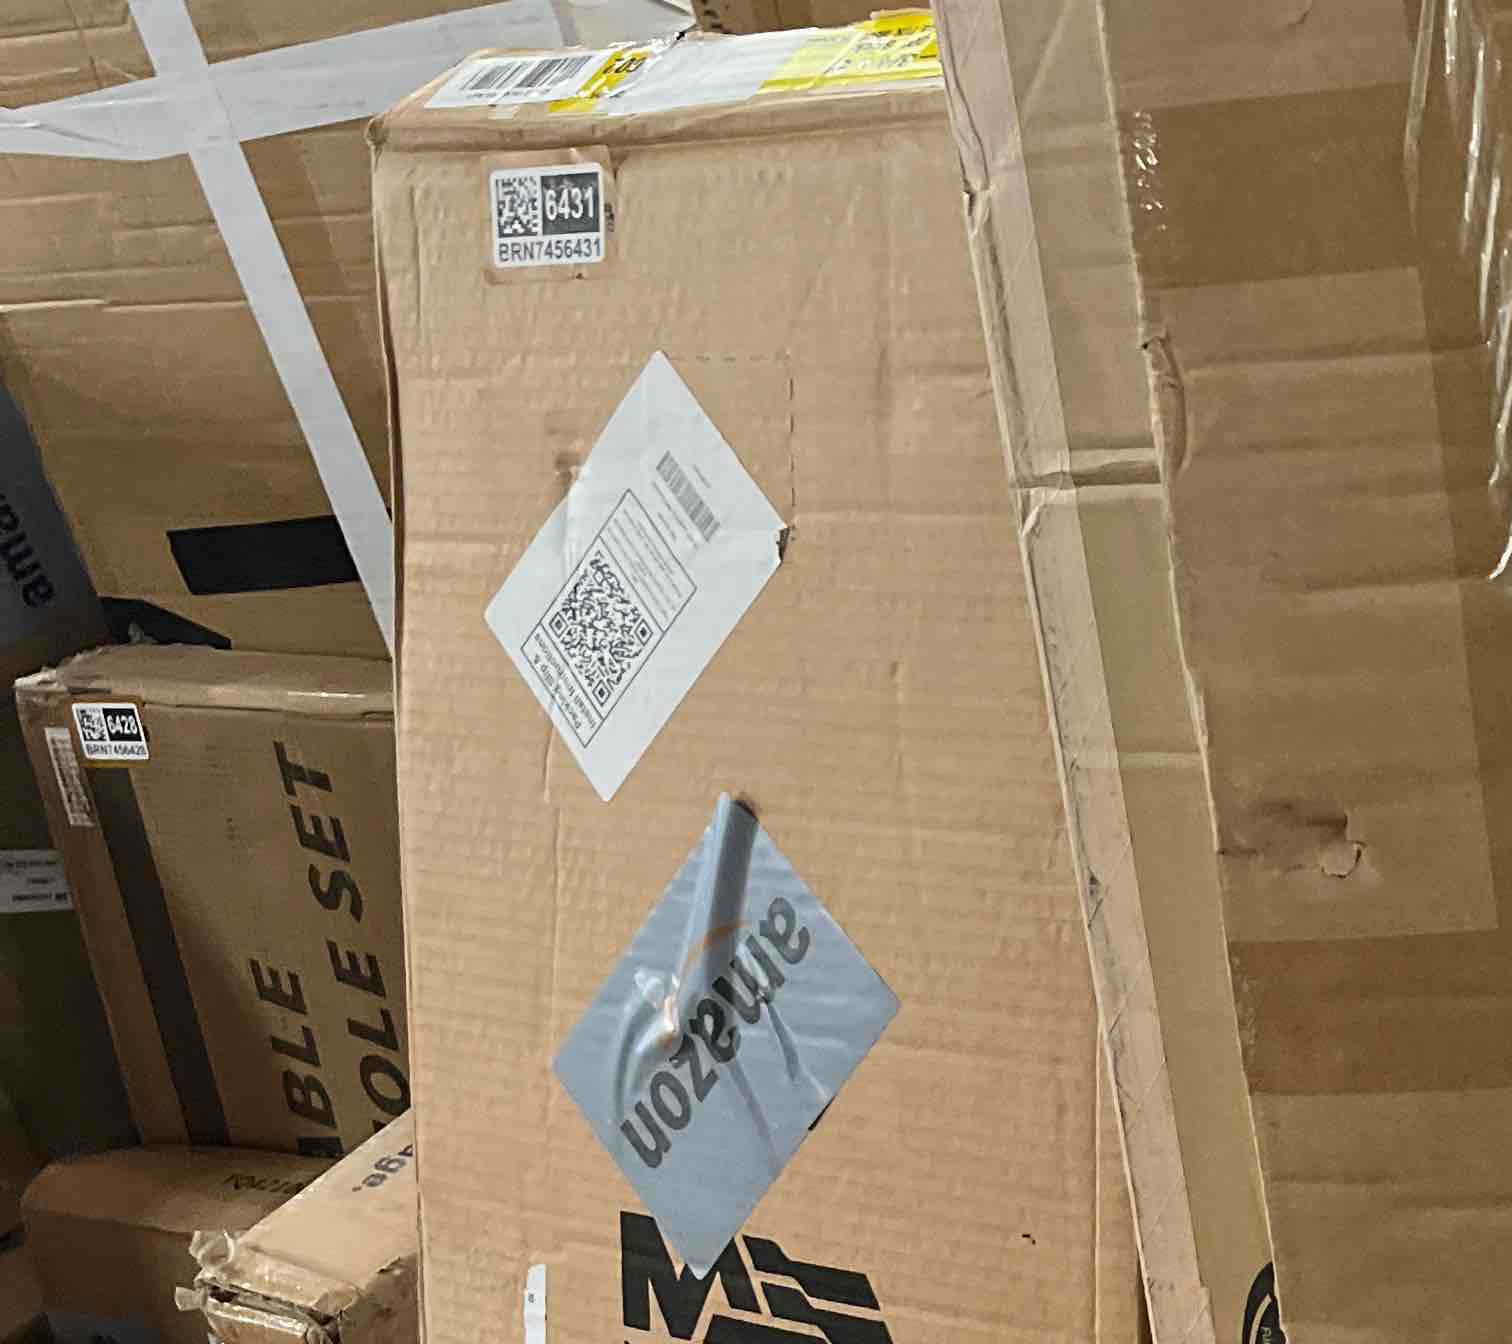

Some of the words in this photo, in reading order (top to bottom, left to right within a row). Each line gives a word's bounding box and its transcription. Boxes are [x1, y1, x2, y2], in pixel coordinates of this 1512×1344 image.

[499, 239, 602, 263] BRN7456431
[545, 186, 595, 221] 6431
[106, 710, 139, 738] 6428
[273, 739, 364, 923] SET
[327, 936, 412, 1134] OLE
[618, 895, 811, 1169] amazon
